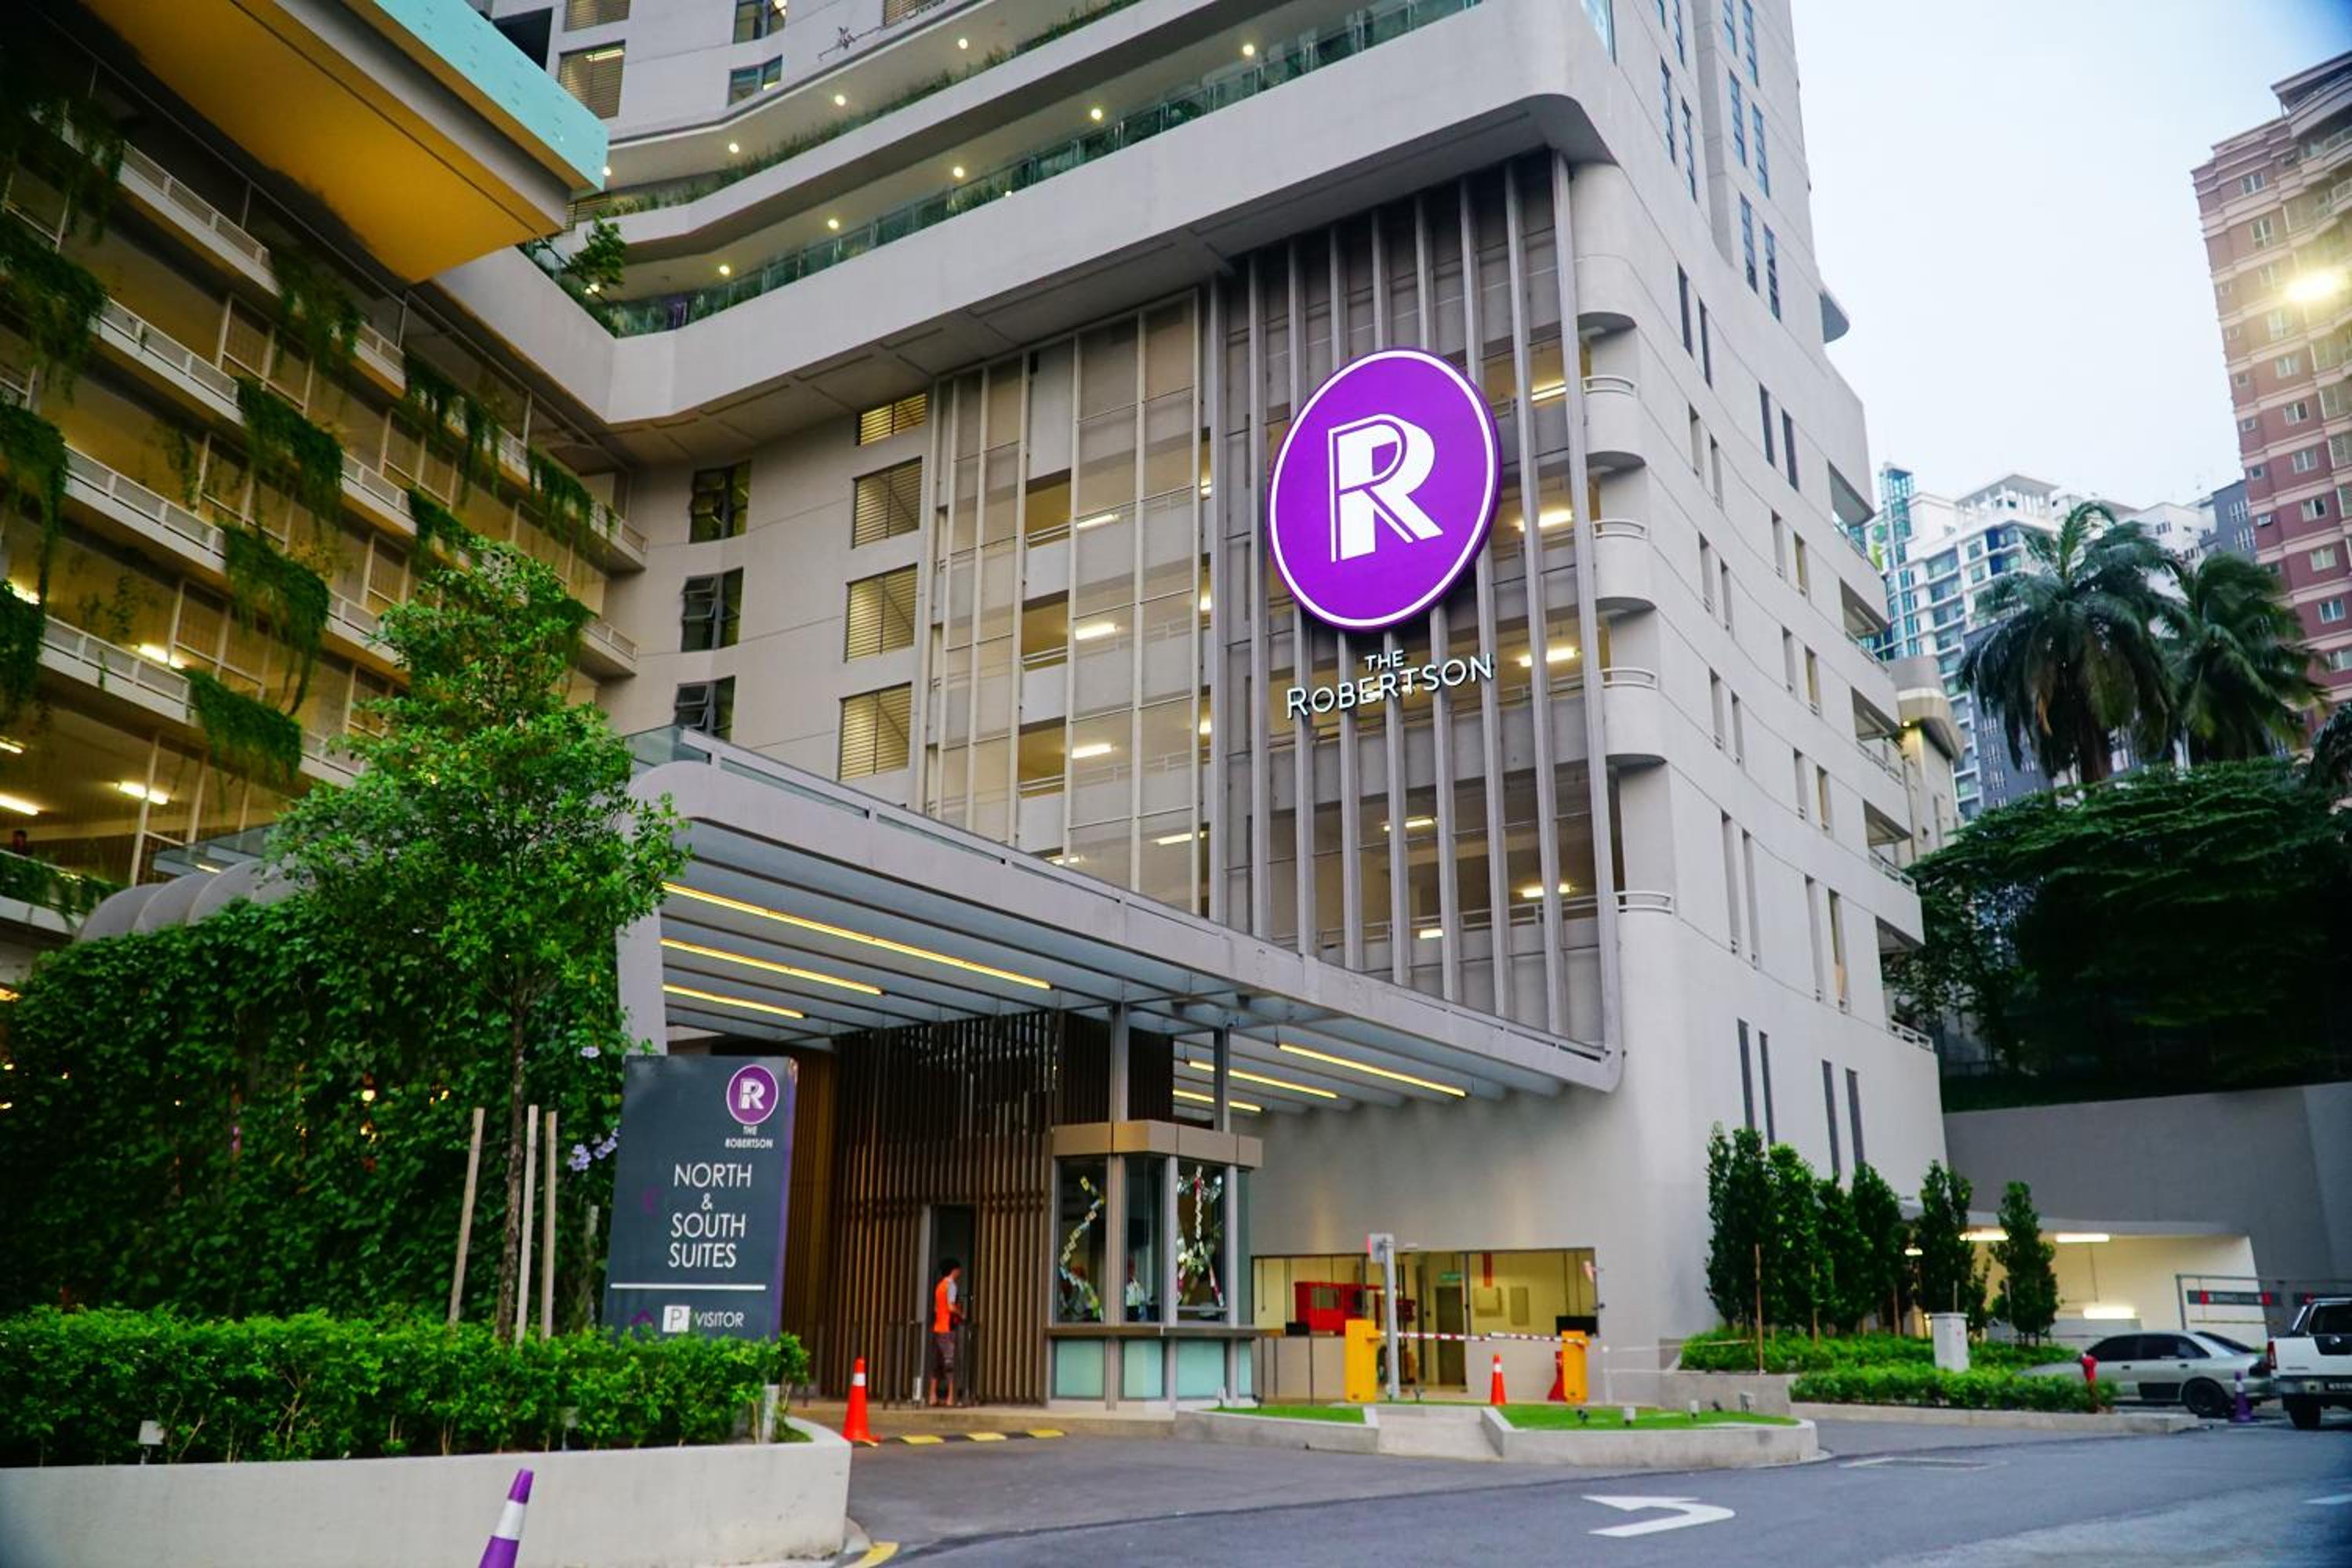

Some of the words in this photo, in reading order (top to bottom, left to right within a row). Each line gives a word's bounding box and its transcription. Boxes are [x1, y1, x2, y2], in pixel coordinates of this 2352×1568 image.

[1327, 413, 1443, 563] R
[1364, 649, 1405, 672] THE
[1287, 652, 1494, 720] ROBERTSON
[739, 1077, 765, 1109] R
[742, 1125, 758, 1135] THE
[724, 1137, 774, 1149] ROBERTSON
[673, 1163, 753, 1188] NORTH
[700, 1192, 713, 1210] &
[670, 1212, 746, 1238] SOUTH
[667, 1242, 737, 1269] SUITES
[670, 1308, 683, 1328] P
[694, 1311, 745, 1328] VISITOR
